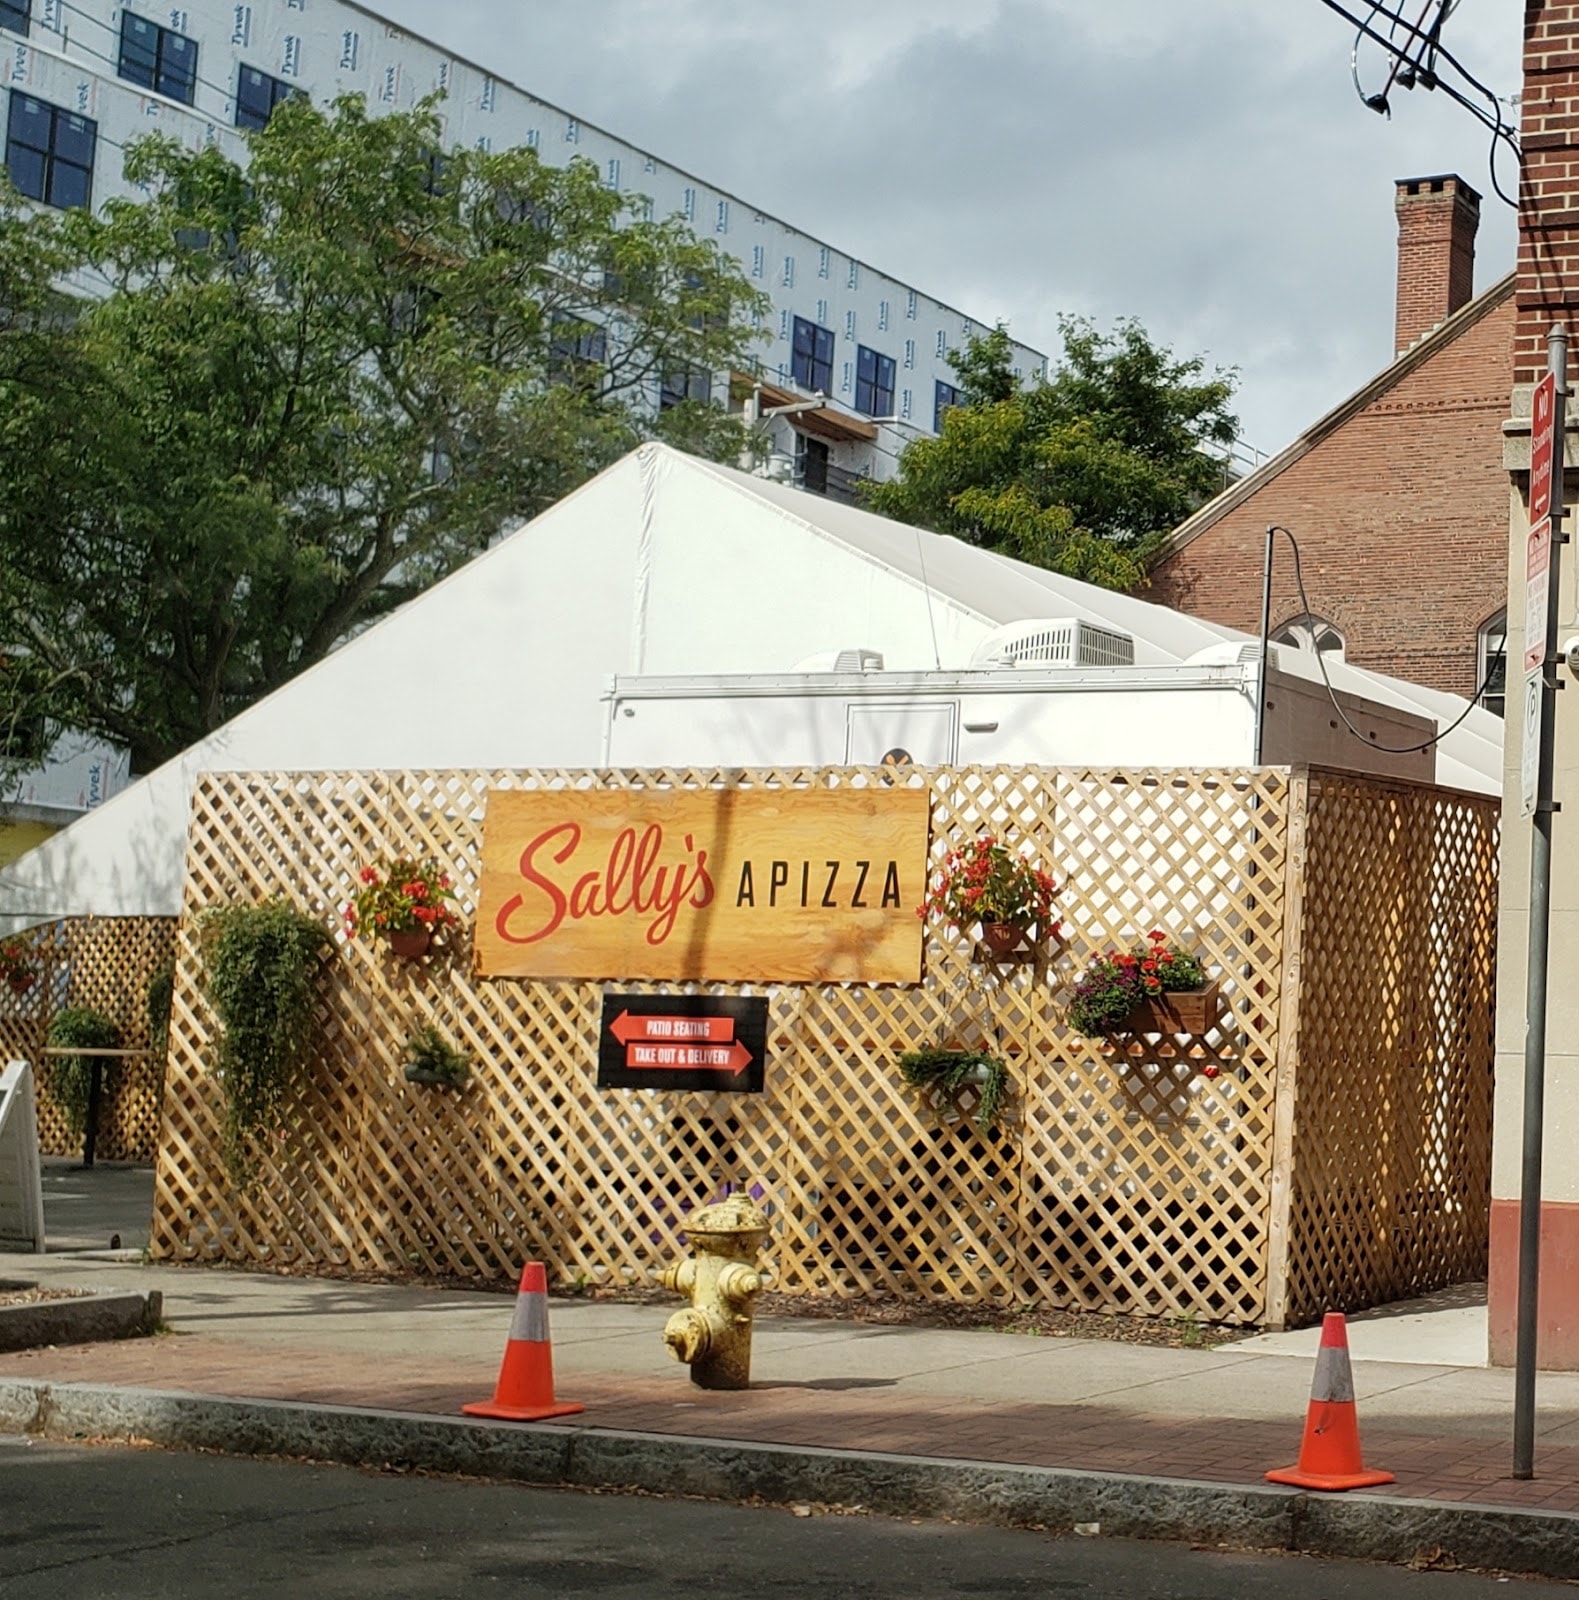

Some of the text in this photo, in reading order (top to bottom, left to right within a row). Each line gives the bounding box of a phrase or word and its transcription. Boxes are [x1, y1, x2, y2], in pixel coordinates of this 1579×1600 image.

[41, 0, 55, 29] Tyve
[231, 4, 244, 46] Tyvek
[12, 47, 26, 82] Tyve
[281, 35, 294, 74] Tyvek
[340, 31, 352, 69] Tyvek
[383, 66, 395, 103] Tyvek
[437, 62, 448, 88] vek
[77, 81, 89, 110] vek
[716, 200, 725, 233] Tyvek
[752, 245, 760, 277] Tyvek
[1538, 389, 1549, 423] NO
[495, 821, 902, 946] Sally's APIZZA
[646, 1020, 710, 1037] PATIO SEATING
[634, 1047, 730, 1065] TAKE OUT & DELIVERY
